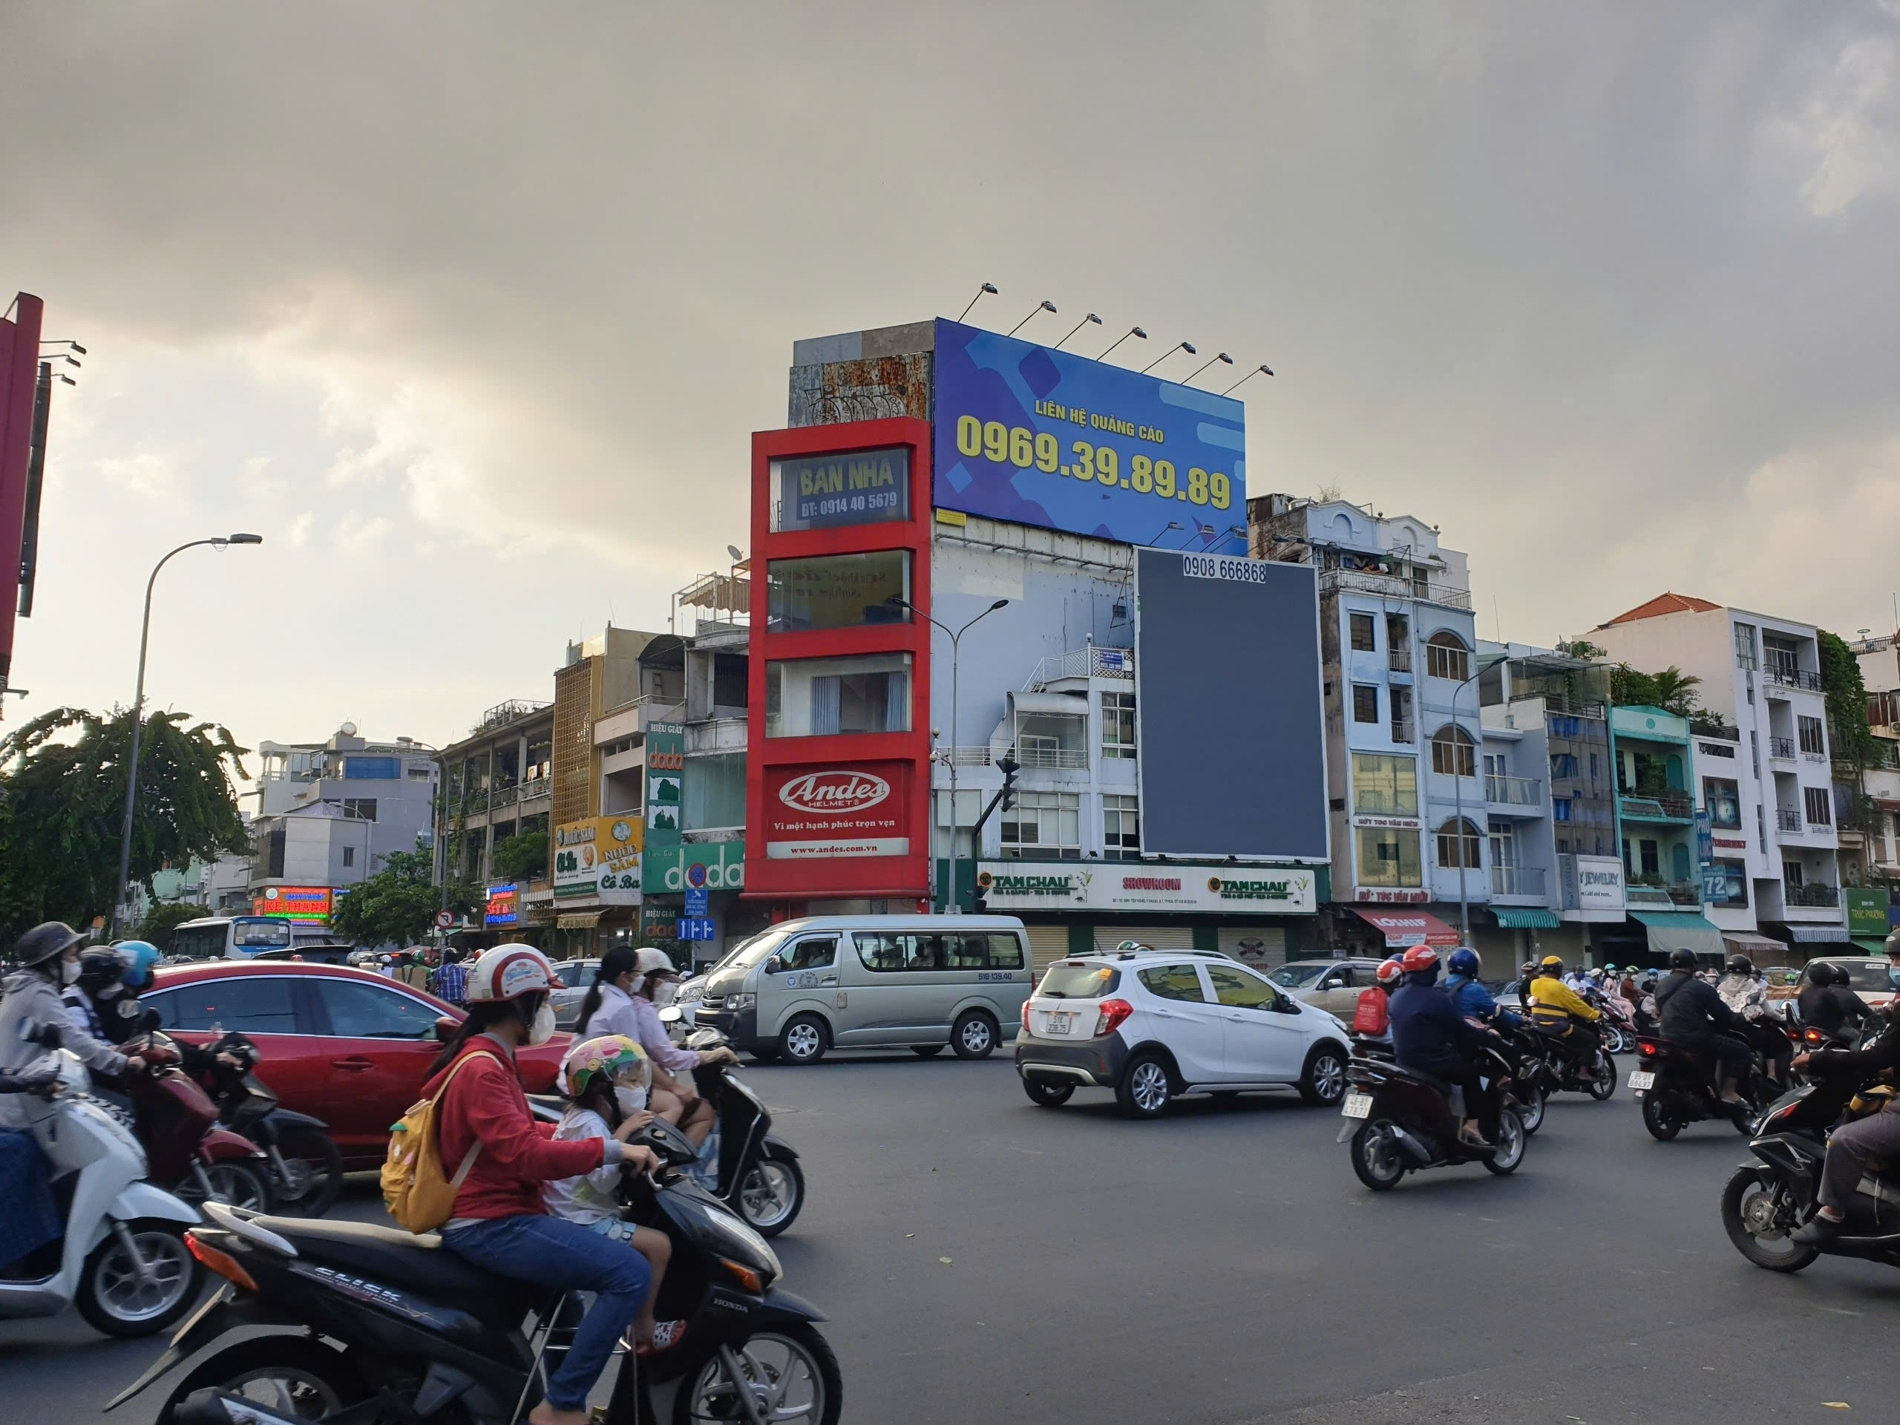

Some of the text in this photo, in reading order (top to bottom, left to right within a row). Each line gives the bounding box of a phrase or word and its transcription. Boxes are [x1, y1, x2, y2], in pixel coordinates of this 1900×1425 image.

[1035, 400, 1164, 443] LIÊN HỆ QUẢNG CÁO
[957, 415, 1231, 510] 0969.39.89.89
[820, 498, 847, 515] 0914
[851, 495, 865, 511] 40
[868, 491, 897, 509] 5679
[1184, 556, 1266, 582] 0908 666868
[649, 742, 684, 770] dada
[784, 775, 886, 802] Andes
[806, 821, 829, 830] hạnh
[831, 820, 853, 830] phúc
[856, 819, 876, 828] trọn
[790, 845, 877, 854] www.andes.com.vn
[601, 875, 617, 889] Cô
[619, 874, 640, 889] Ba
[1123, 877, 1182, 890] SHOWROOM
[1704, 877, 1725, 894] 72
[714, 1298, 749, 1312] HONDA
